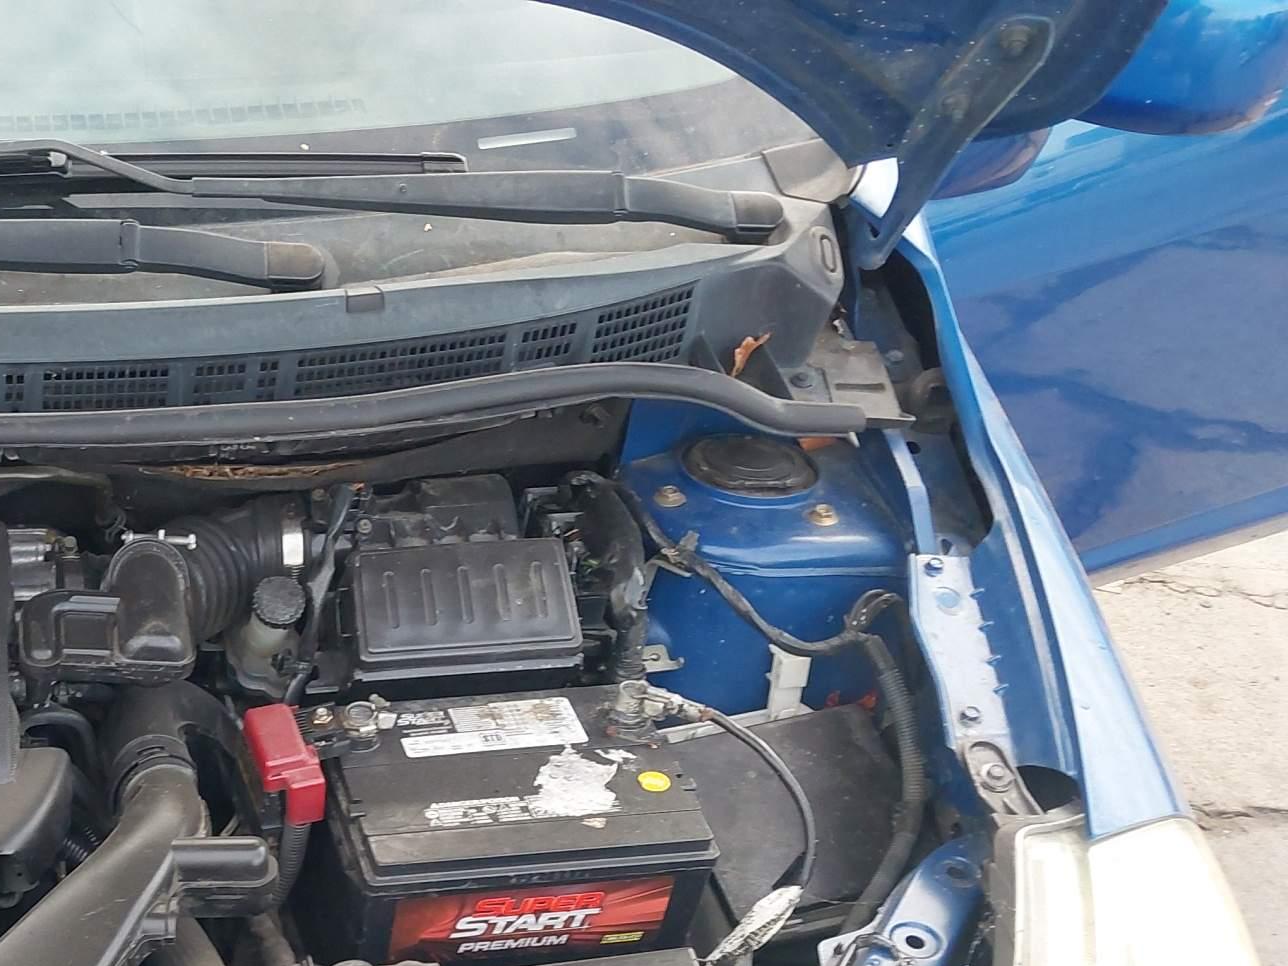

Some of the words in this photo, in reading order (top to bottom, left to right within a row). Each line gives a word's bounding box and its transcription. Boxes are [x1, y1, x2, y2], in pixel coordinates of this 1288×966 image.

[475, 891, 605, 916] SUPER
[449, 908, 601, 939] START
[457, 934, 570, 954] PREMIUM
